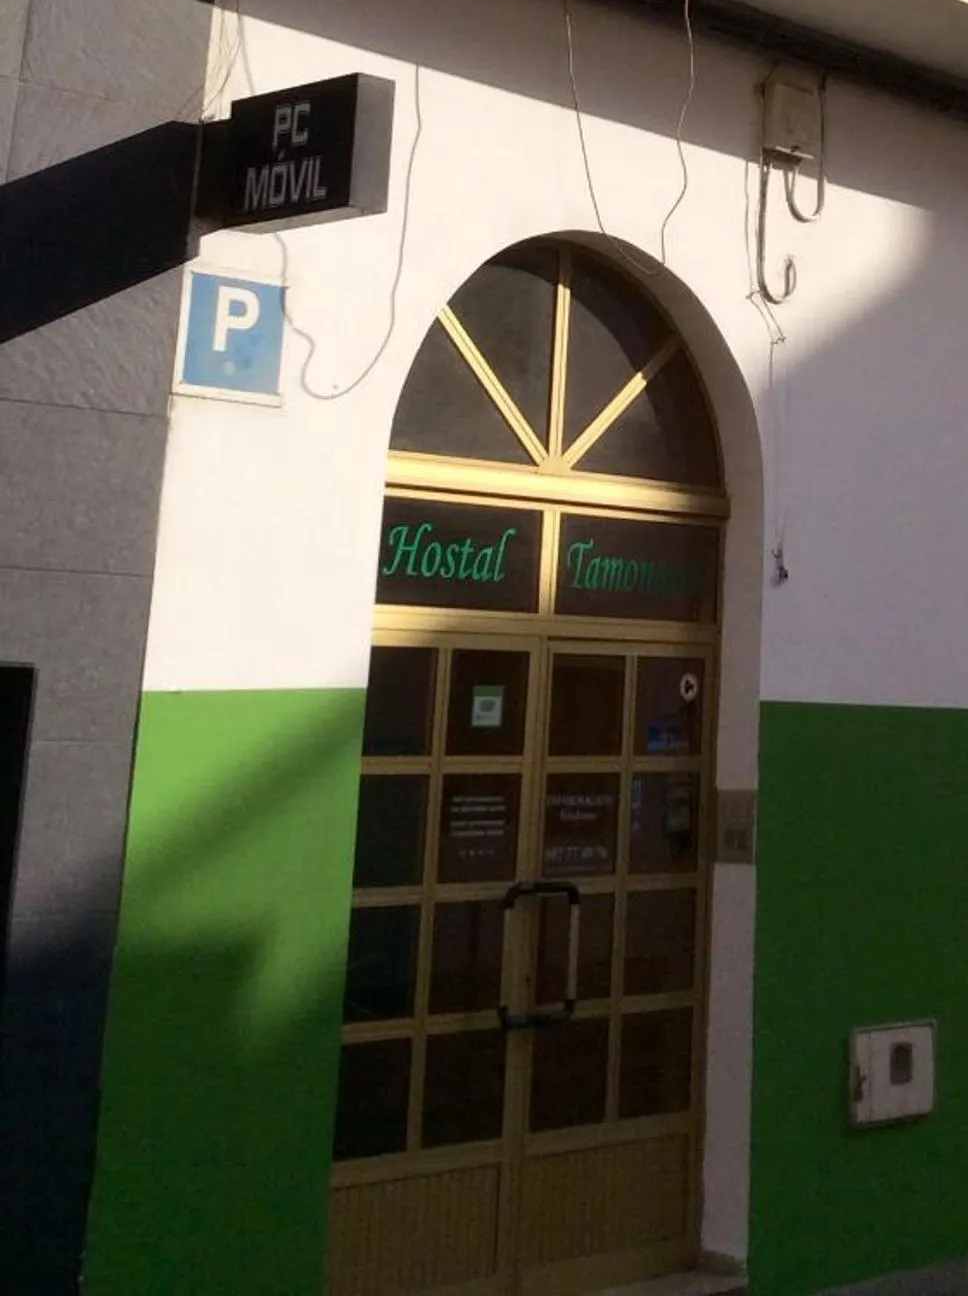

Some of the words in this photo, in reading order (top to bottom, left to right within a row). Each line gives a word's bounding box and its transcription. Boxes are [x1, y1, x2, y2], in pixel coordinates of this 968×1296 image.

[273, 102, 311, 149] PC
[213, 286, 259, 352] P
[383, 521, 516, 583] Hostal
